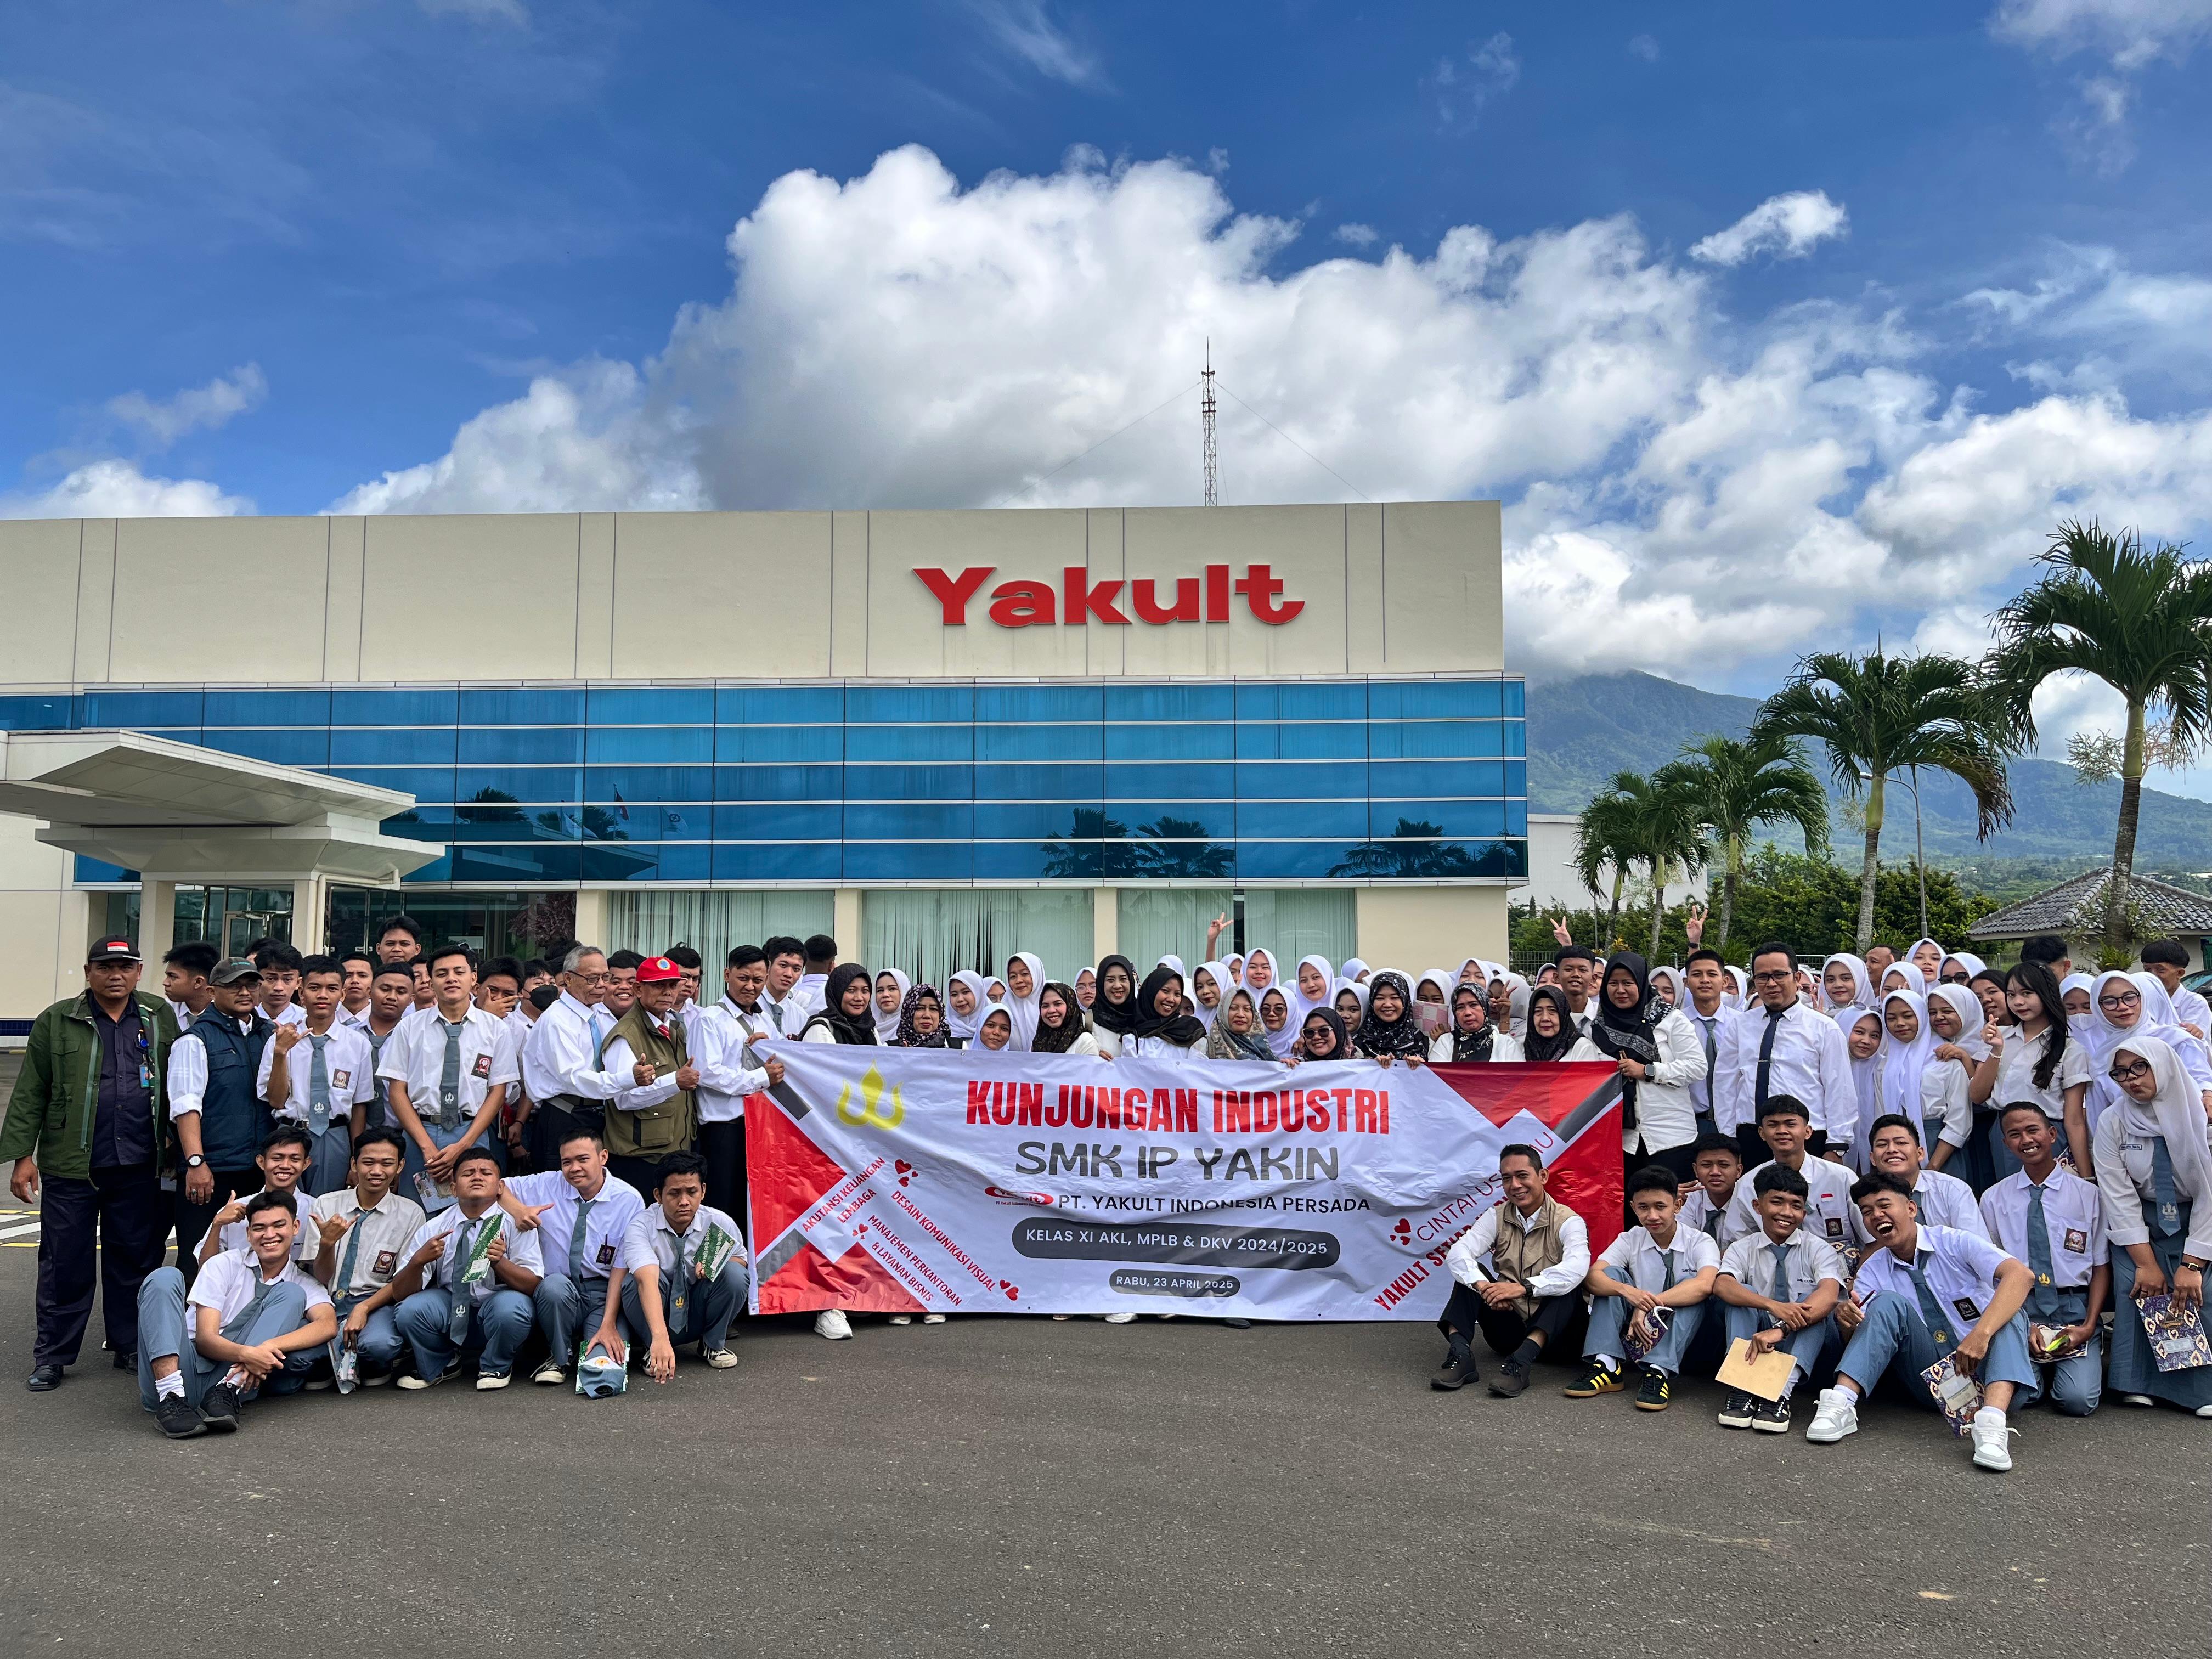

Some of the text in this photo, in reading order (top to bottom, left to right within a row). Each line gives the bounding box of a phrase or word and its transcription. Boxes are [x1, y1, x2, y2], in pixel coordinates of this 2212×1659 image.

[912, 564, 1306, 627] Yakult
[966, 1080, 1390, 1135] KUNJUNGAN INDUSTRI
[1015, 1141, 1339, 1181] SMK IP YAKIN
[802, 1156, 886, 1232] AKUTANSI KEUANGAN
[836, 1188, 877, 1224] LEMBAGA
[1059, 1195, 1371, 1214] PT. YAKULT INDONESIA PERSADA
[1417, 1193, 1477, 1241] CINTAI
[868, 1214, 962, 1306] MANAJEMEN PERKANTORAN
[891, 1190, 996, 1291] DESAIN KOMUNIKASI VISUAL
[1026, 1229, 1327, 1255] KELAS XI AKL, MPLB & DKV 2024/2025
[871, 1242, 934, 1302] & LAYANAN BISNIS
[1116, 1276, 1234, 1290] RABU, 23 APRIL 2025
[1373, 1261, 1430, 1311] YAKULT
